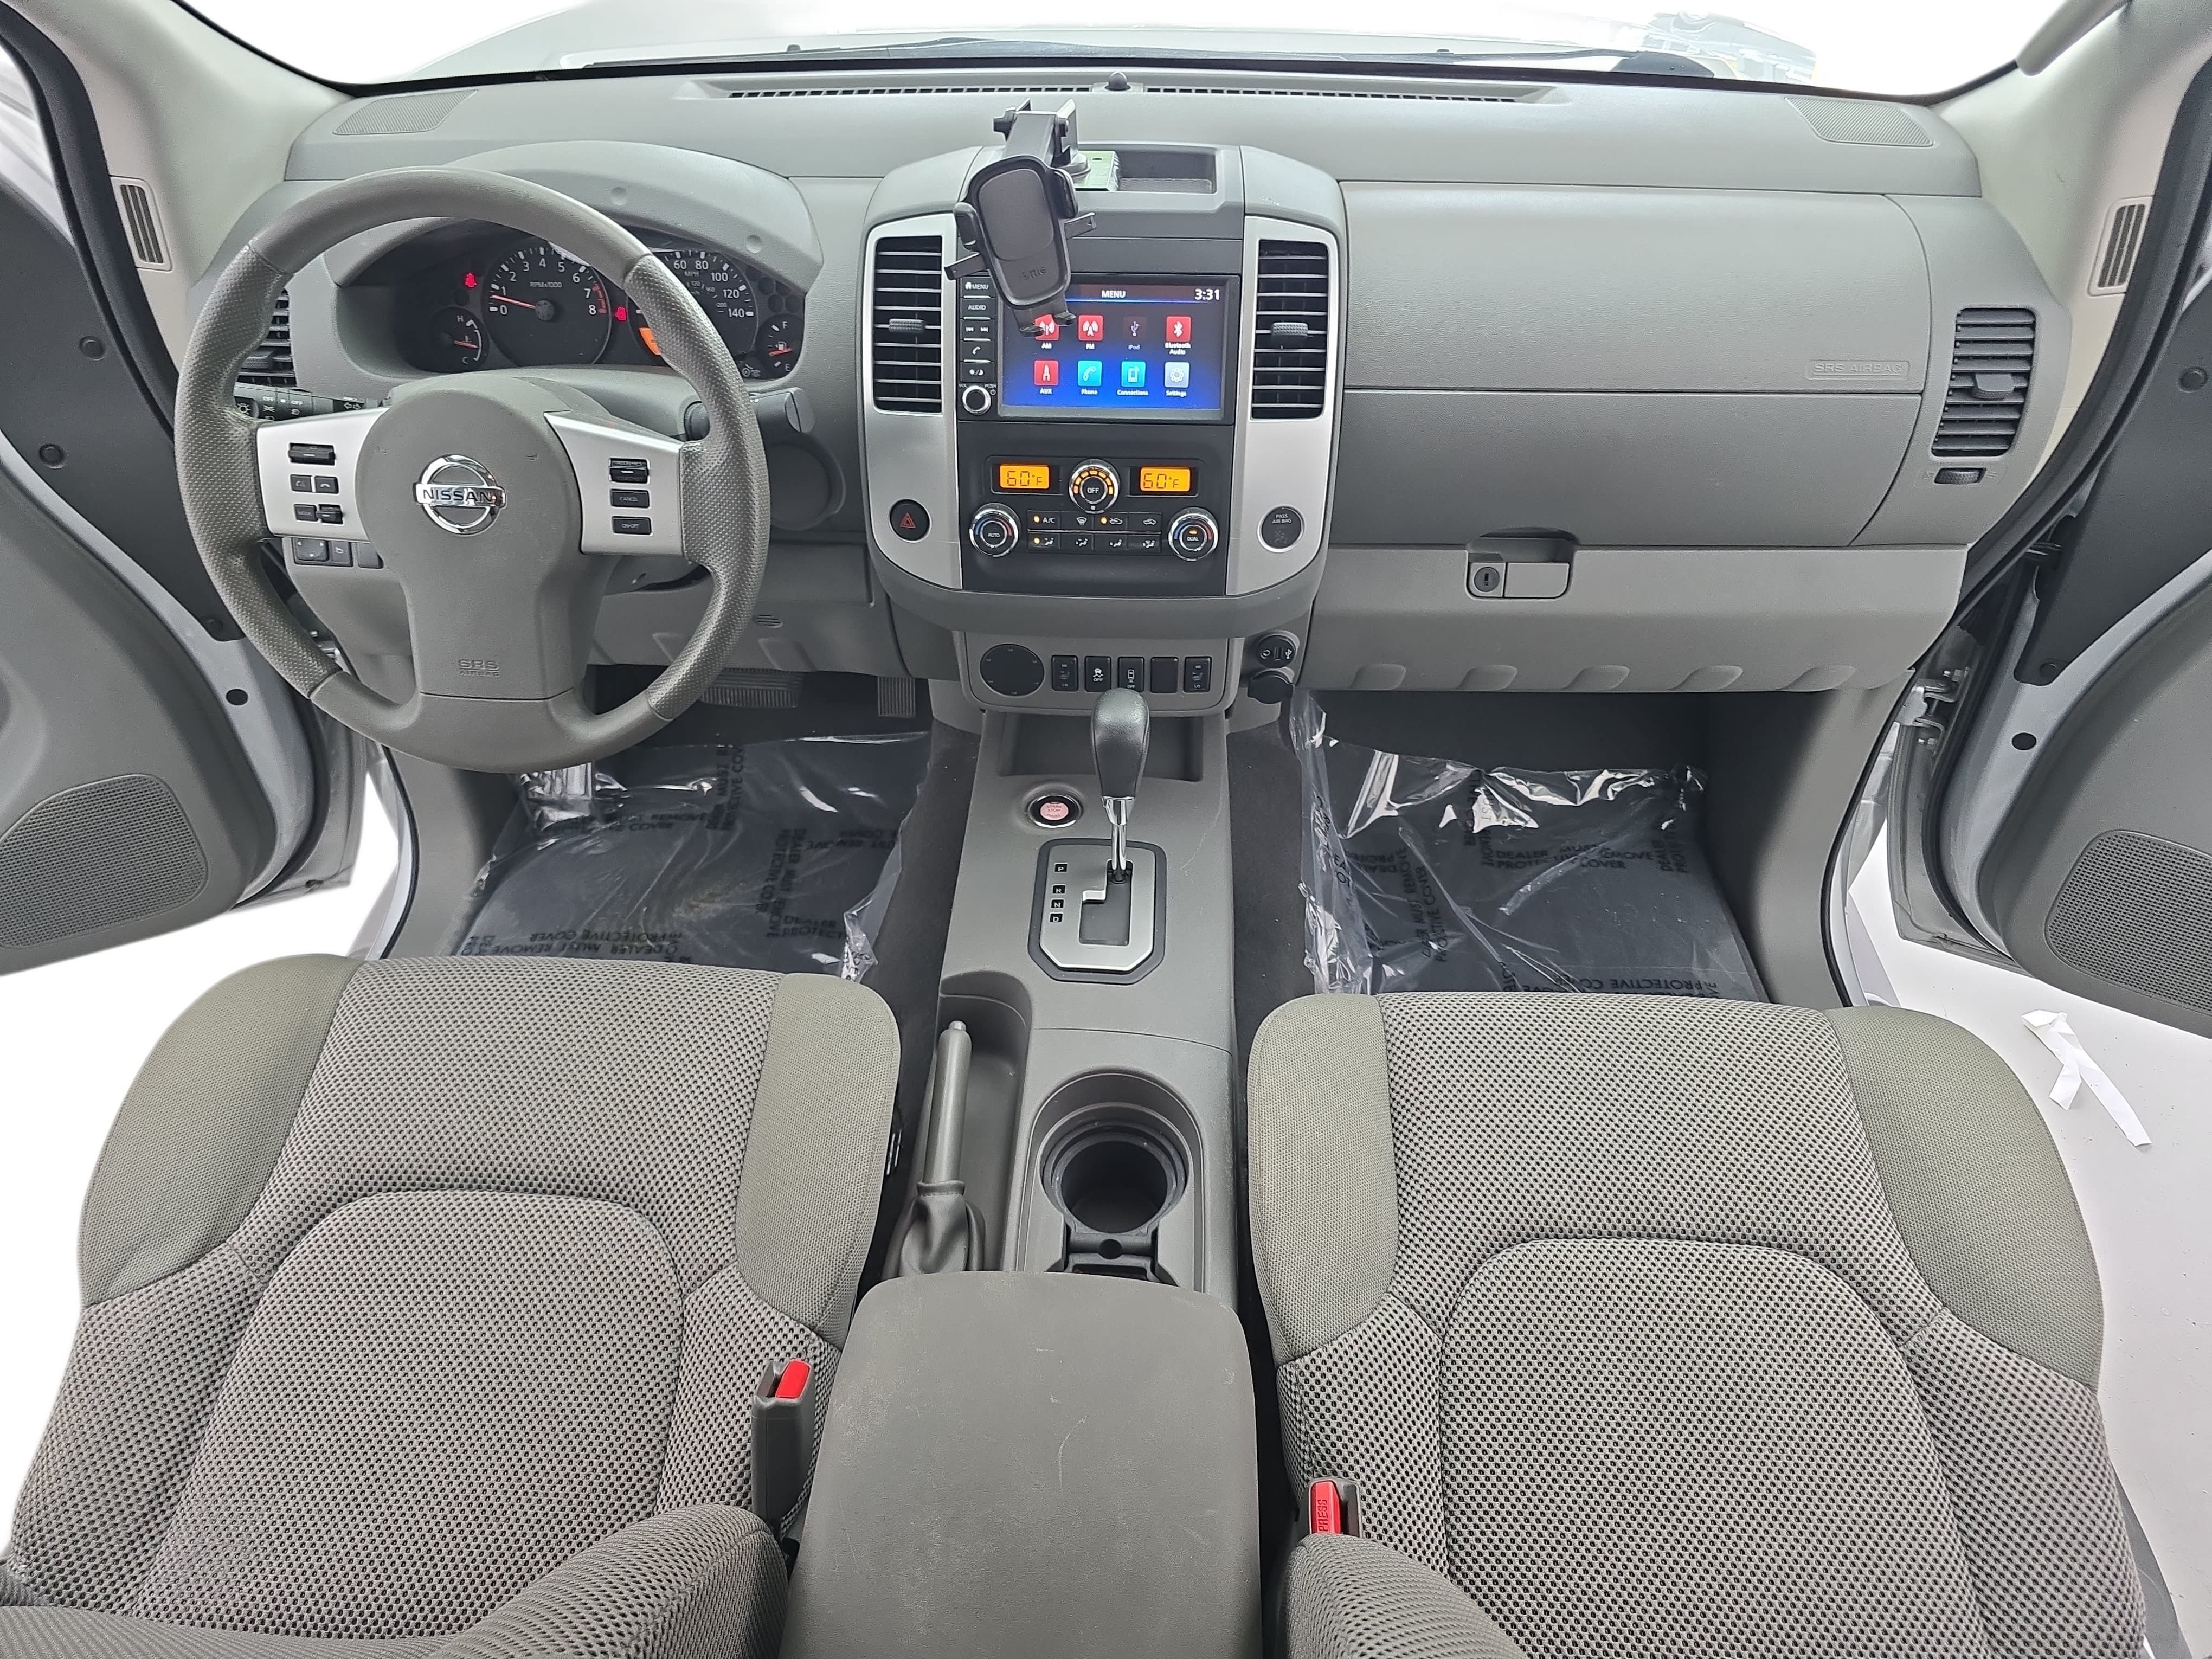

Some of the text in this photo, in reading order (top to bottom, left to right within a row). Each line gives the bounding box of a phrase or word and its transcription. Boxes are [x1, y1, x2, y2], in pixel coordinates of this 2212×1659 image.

[522, 261, 530, 272] 3
[539, 258, 546, 268] 4
[558, 262, 565, 272] 5
[673, 260, 687, 269] 60
[695, 260, 709, 269] 80
[509, 272, 516, 281] 2
[573, 273, 581, 282] 6
[711, 272, 728, 281] 100
[501, 286, 506, 295] 1
[584, 288, 591, 298] 7
[723, 289, 740, 298] 120
[1101, 290, 1126, 298] MENU
[1194, 289, 1220, 300] 3:31
[500, 305, 507, 315] 0
[589, 304, 596, 314] 8
[728, 308, 744, 318] 140
[1814, 363, 1903, 374] SRS AIRBAG
[423, 489, 492, 502] NISSAN
[458, 659, 499, 668] SRS
[1496, 850, 1549, 859] DEALER
[1609, 978, 1702, 991] PROTECTIVE
[1317, 1499, 1329, 1533] PRESS
